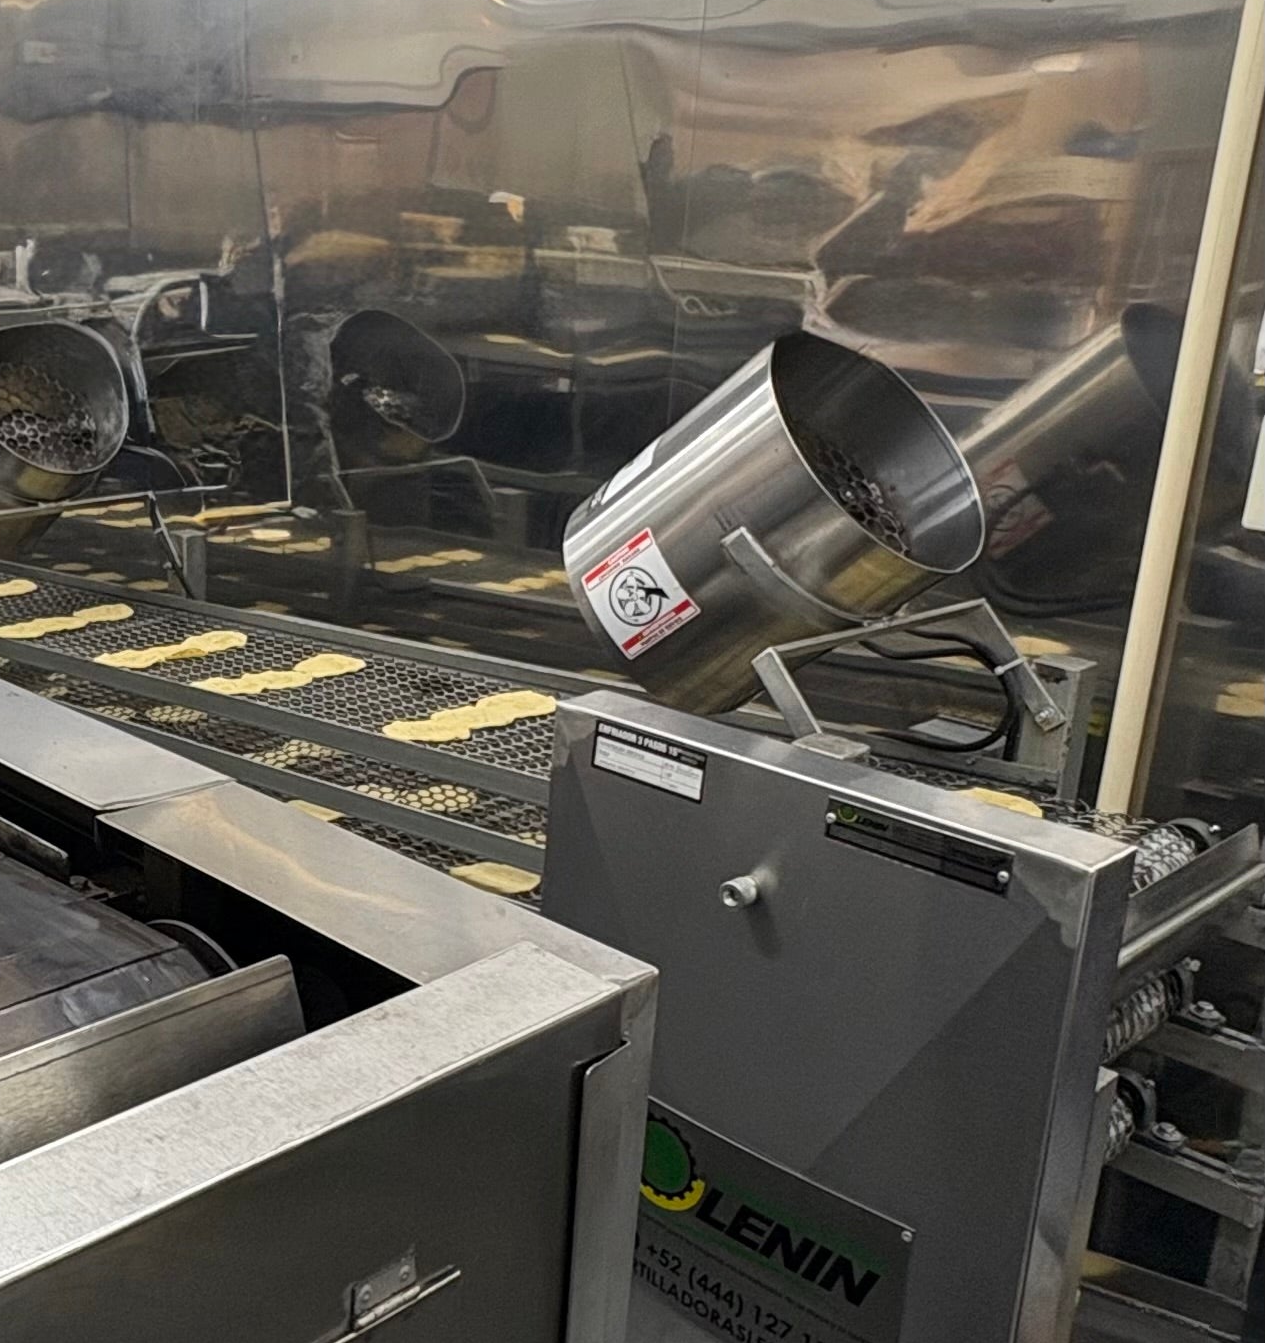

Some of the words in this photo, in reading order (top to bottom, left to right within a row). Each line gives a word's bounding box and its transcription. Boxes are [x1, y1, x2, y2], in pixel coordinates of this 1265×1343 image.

[647, 1243, 682, 1277] +52
[688, 1266, 744, 1319] (444)
[754, 1304, 793, 1340] 127
[695, 1188, 880, 1307] LENIN
